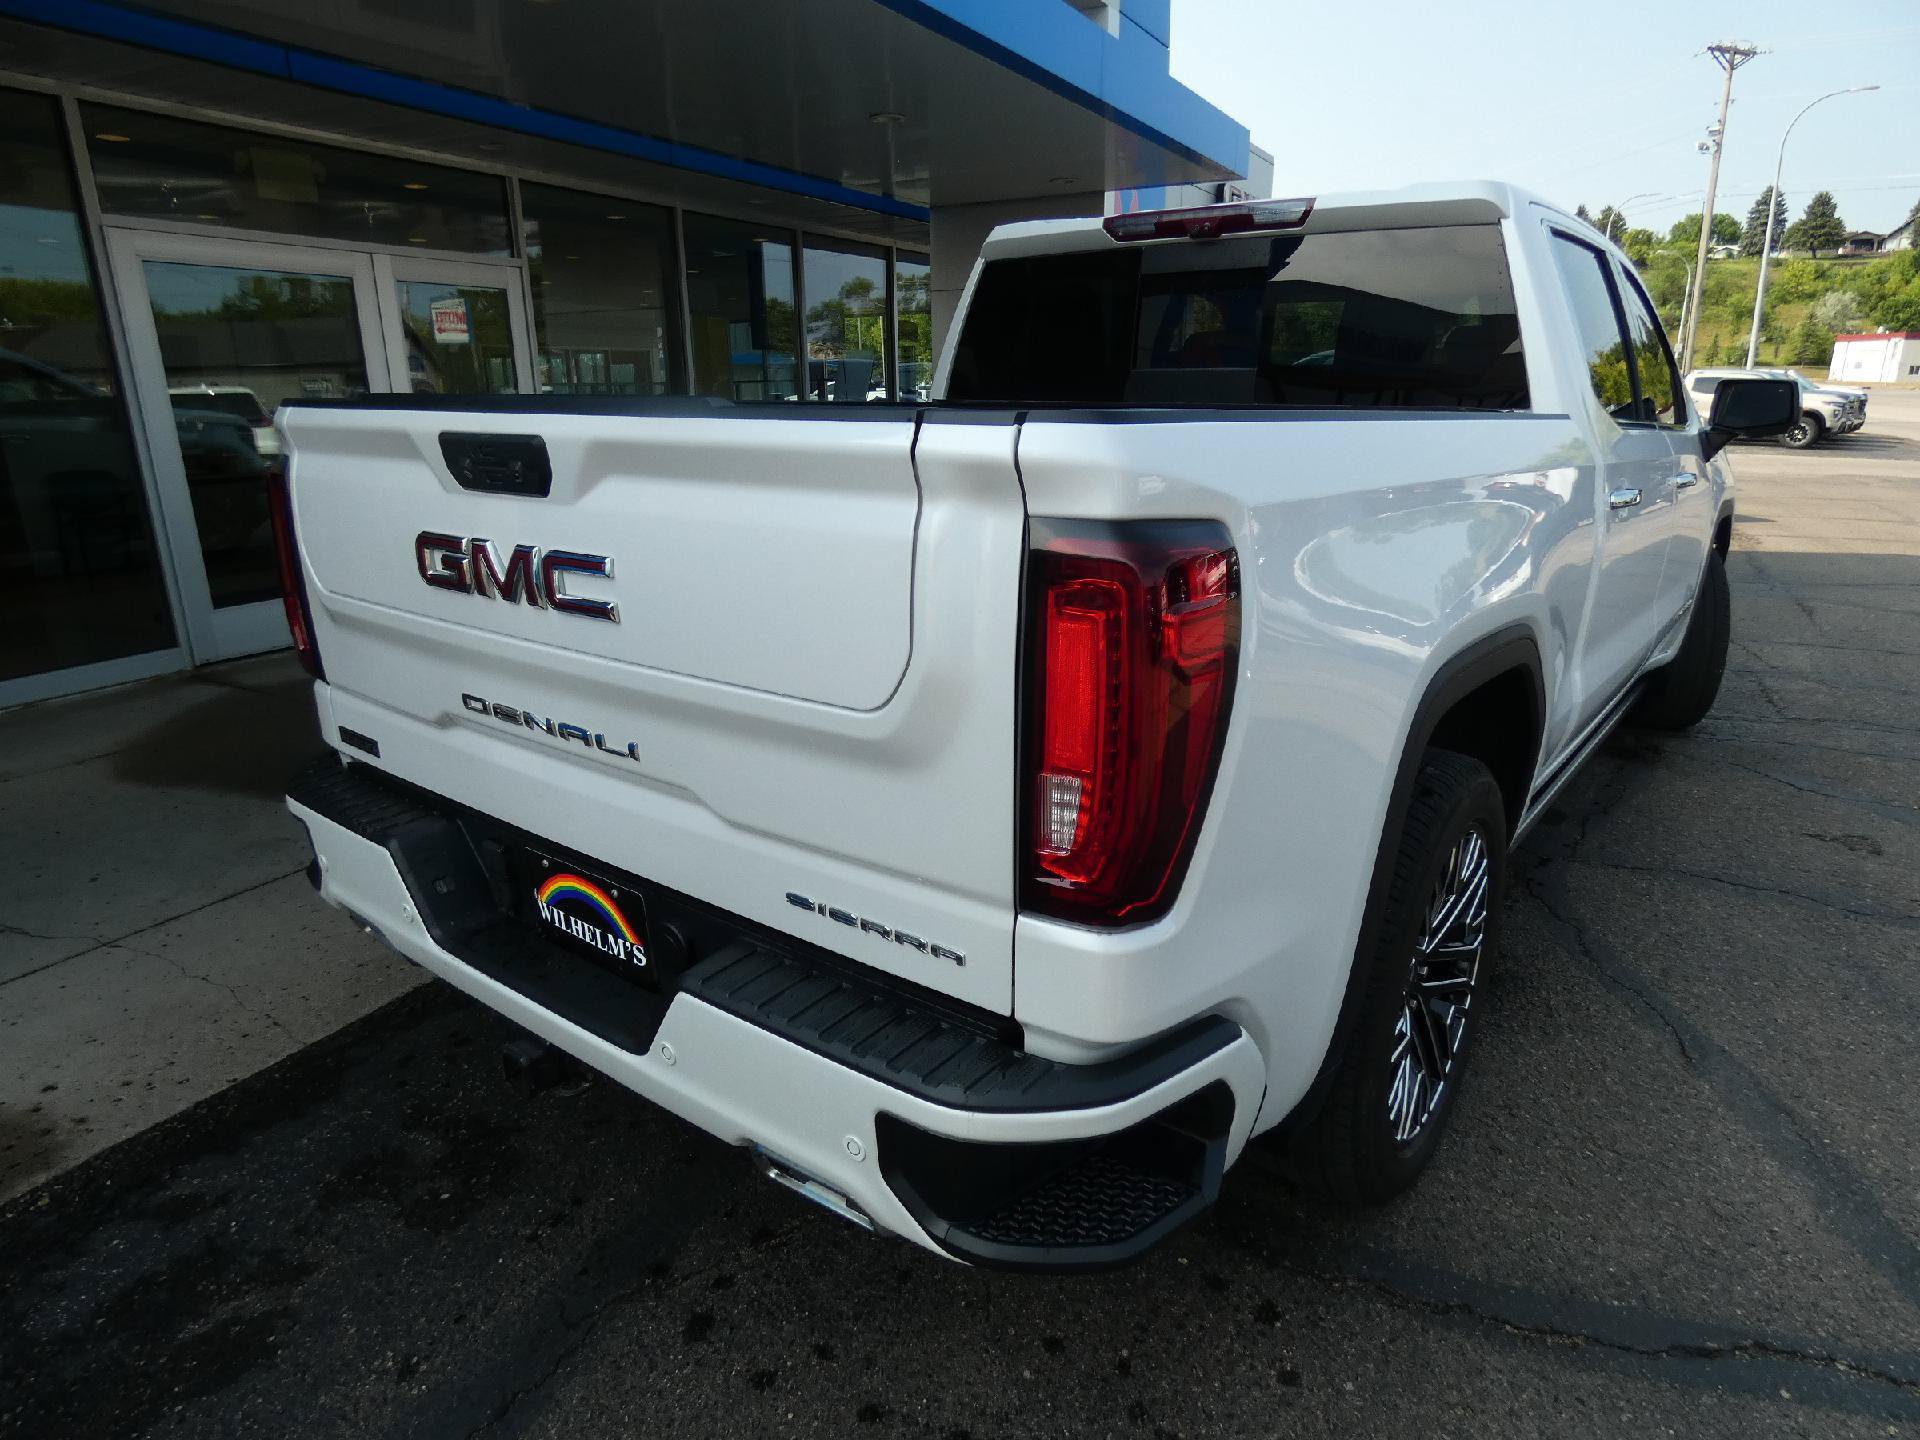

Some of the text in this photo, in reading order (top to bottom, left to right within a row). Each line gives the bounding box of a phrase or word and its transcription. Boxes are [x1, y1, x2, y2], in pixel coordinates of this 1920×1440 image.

[415, 531, 621, 624] GMC
[461, 693, 641, 762] DENALI
[534, 888, 647, 967] WILHELM'S
[785, 892, 967, 967] SIERRA
